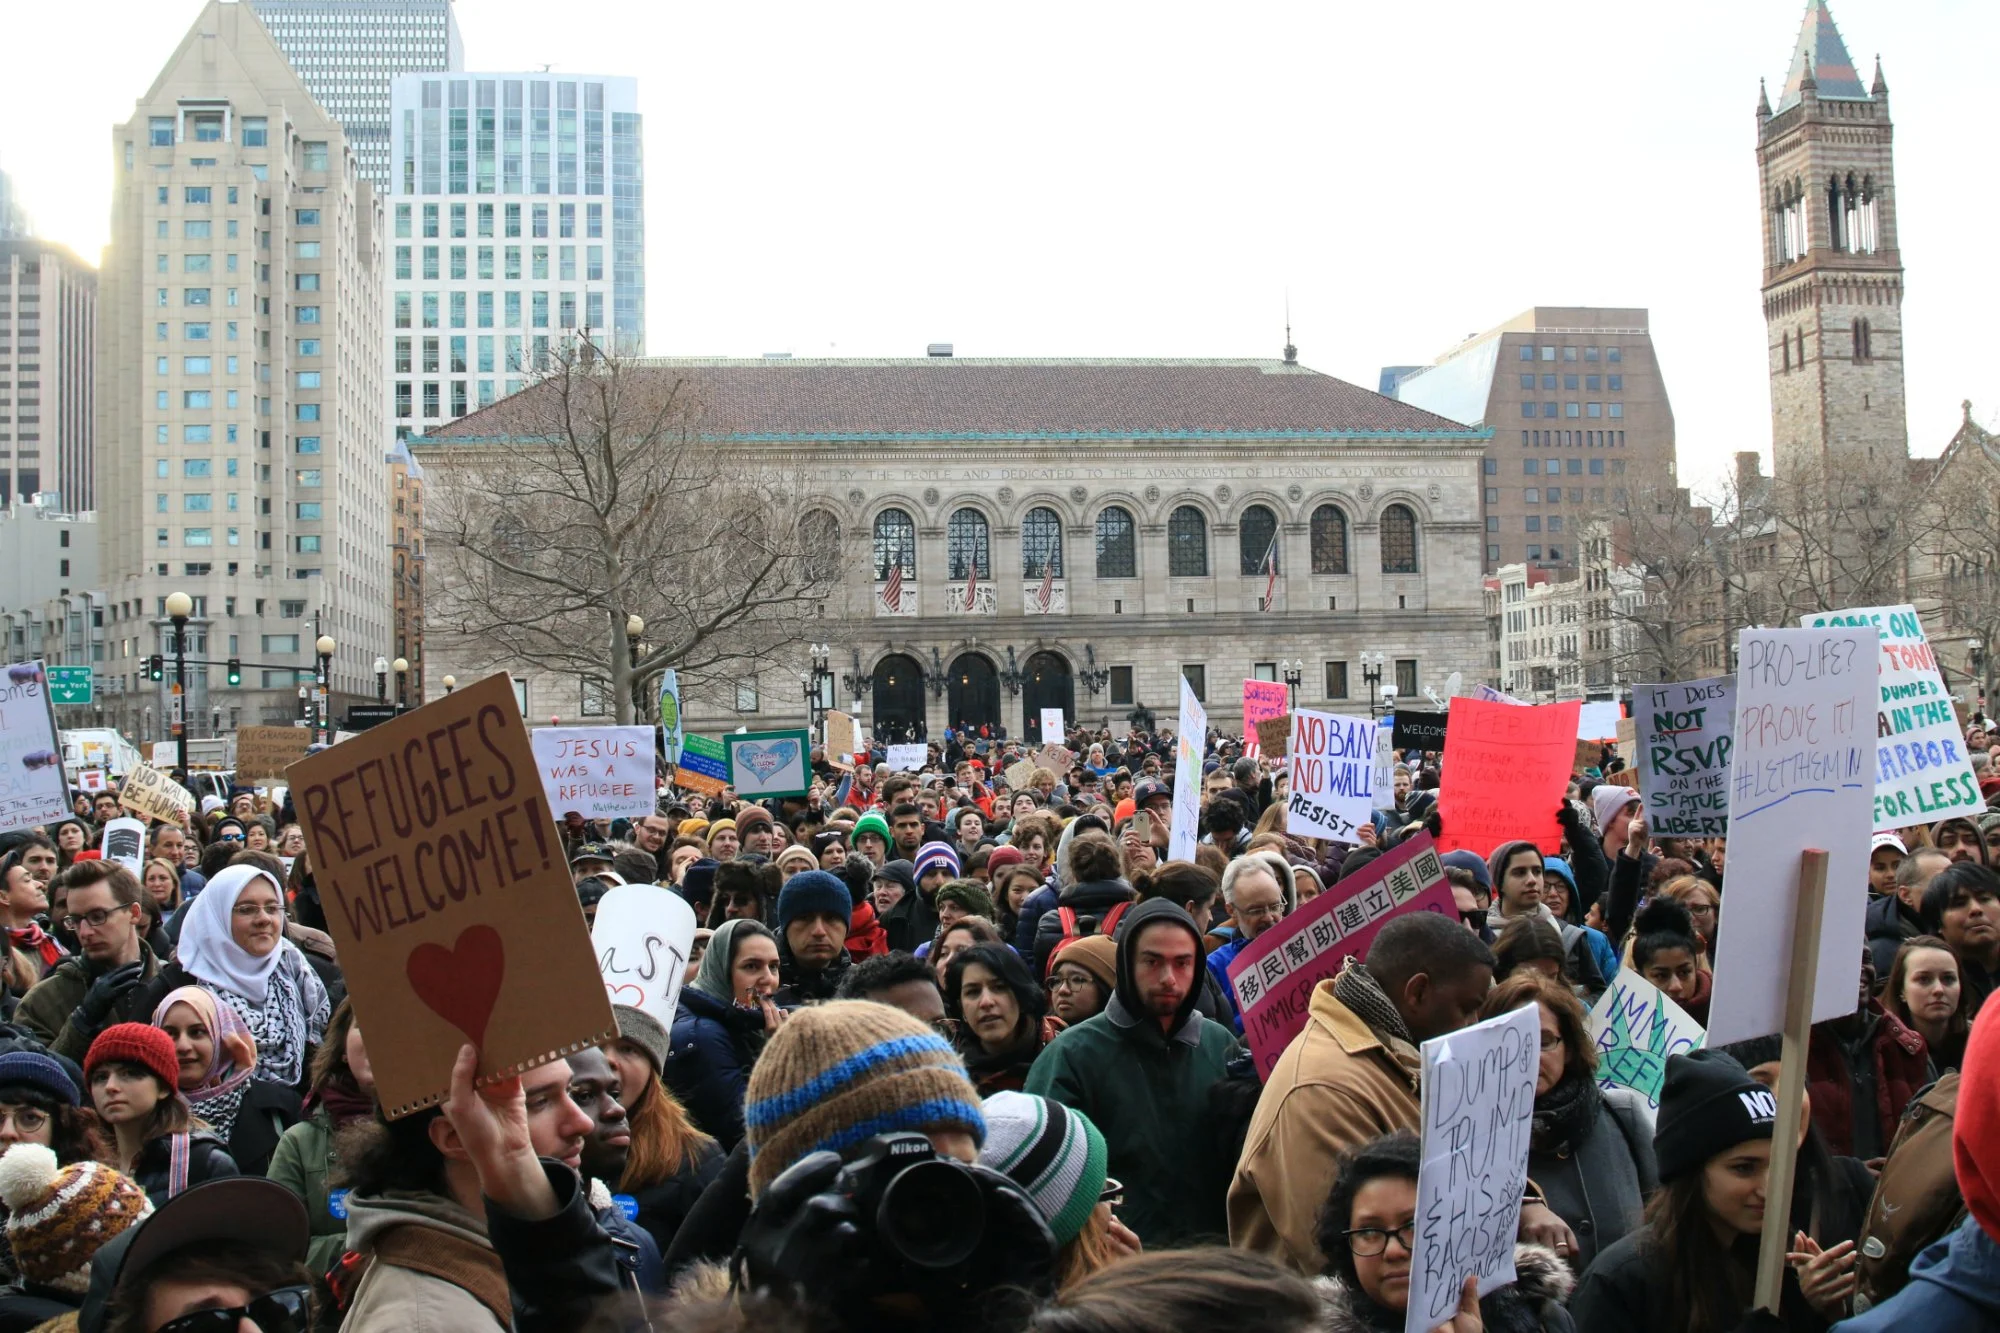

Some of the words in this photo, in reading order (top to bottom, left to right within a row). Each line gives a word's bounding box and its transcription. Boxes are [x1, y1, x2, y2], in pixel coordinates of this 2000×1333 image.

[840, 470, 856, 480] BY
[866, 470, 895, 480] THE
[904, 469, 951, 480] PEOPLE
[963, 469, 990, 480] AND
[1001, 469, 1074, 479] DEDICATED
[1086, 469, 1103, 479] TO
[1112, 468, 1136, 479] THE
[1145, 468, 1236, 478] ADVANCEMENT
[1246, 468, 1261, 478] OF
[1271, 467, 1333, 477] LEARNING
[1890, 612, 1925, 643] ON,
[1747, 638, 1857, 689] PRO-LIFE?
[1245, 682, 1285, 708] Solidarity
[1652, 690, 1669, 708] IT
[1684, 684, 1725, 704] DOES
[1881, 680, 1939, 703] DUMPED
[1401, 723, 1447, 737] WELCOME
[1653, 707, 1707, 733] NOT
[1742, 703, 1818, 751] PROVE
[1833, 696, 1856, 740] IT!
[1893, 706, 1914, 733] IN
[1912, 700, 1953, 728] THE
[554, 739, 638, 759] JESUS
[1294, 715, 1326, 756] NO
[1328, 719, 1377, 760] BAN
[1650, 732, 1677, 749] SAY
[551, 765, 588, 779] WAS
[605, 764, 615, 777] A
[1292, 756, 1323, 794] NO
[1329, 760, 1372, 798] WALL
[1875, 738, 1962, 784] ARBOR
[124, 783, 145, 804] BE
[132, 767, 158, 787] NO
[160, 779, 188, 808] WALL
[303, 703, 517, 869] REFUGEES
[559, 783, 637, 801] REFUGEE
[1670, 778, 1688, 790] ON
[1695, 772, 1724, 790] THE
[1874, 790, 1915, 823] FOR
[1915, 771, 1978, 814] LESS
[1288, 792, 1355, 837] RESIST
[1650, 790, 1728, 811] STATUE
[1678, 808, 1699, 819] OF
[332, 796, 551, 942] WELCOME!
[1238, 850, 1442, 1005] 移民幫助建立美國
[1435, 1027, 1521, 1130] DUMP
[890, 1142, 929, 1155] Nikon
[1441, 1080, 1534, 1193] TRUMP
[1449, 1174, 1494, 1230] HIS
[1425, 1208, 1513, 1294] RACIST
